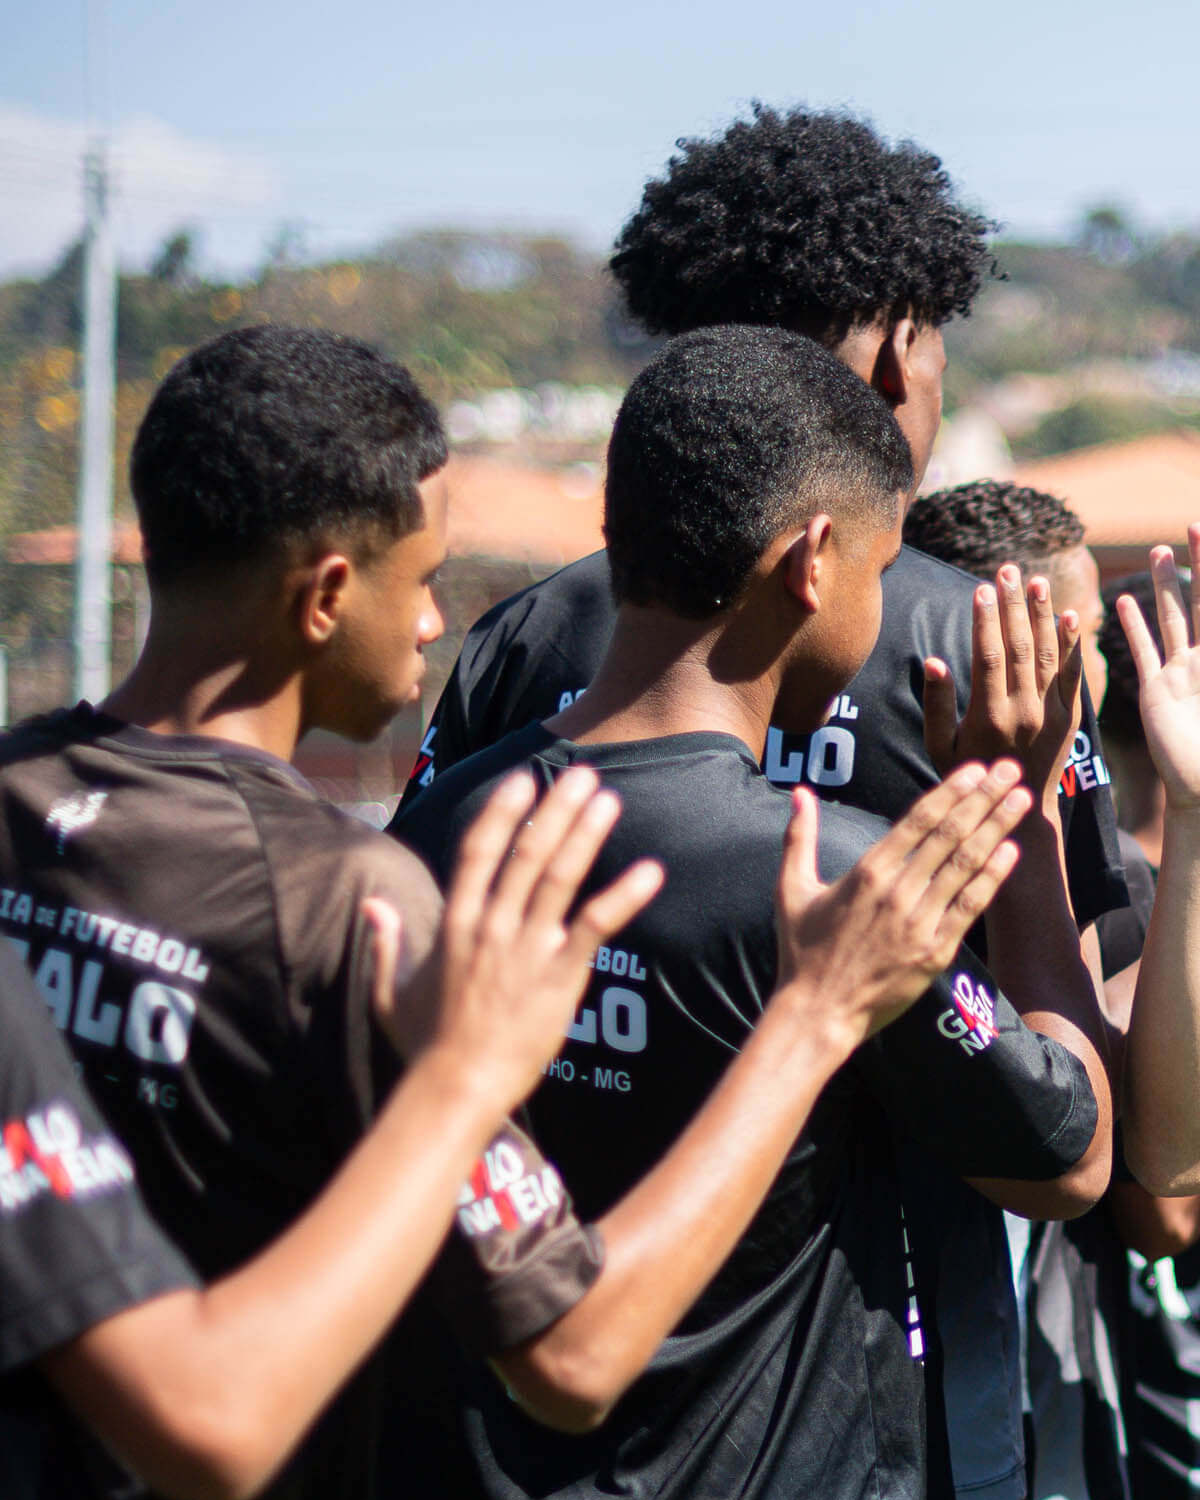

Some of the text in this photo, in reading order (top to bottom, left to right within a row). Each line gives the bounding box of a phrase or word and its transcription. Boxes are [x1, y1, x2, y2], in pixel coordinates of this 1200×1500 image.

[766, 726, 856, 787] LO
[59, 907, 210, 983] FUTEBOL
[595, 1067, 632, 1092] MG
